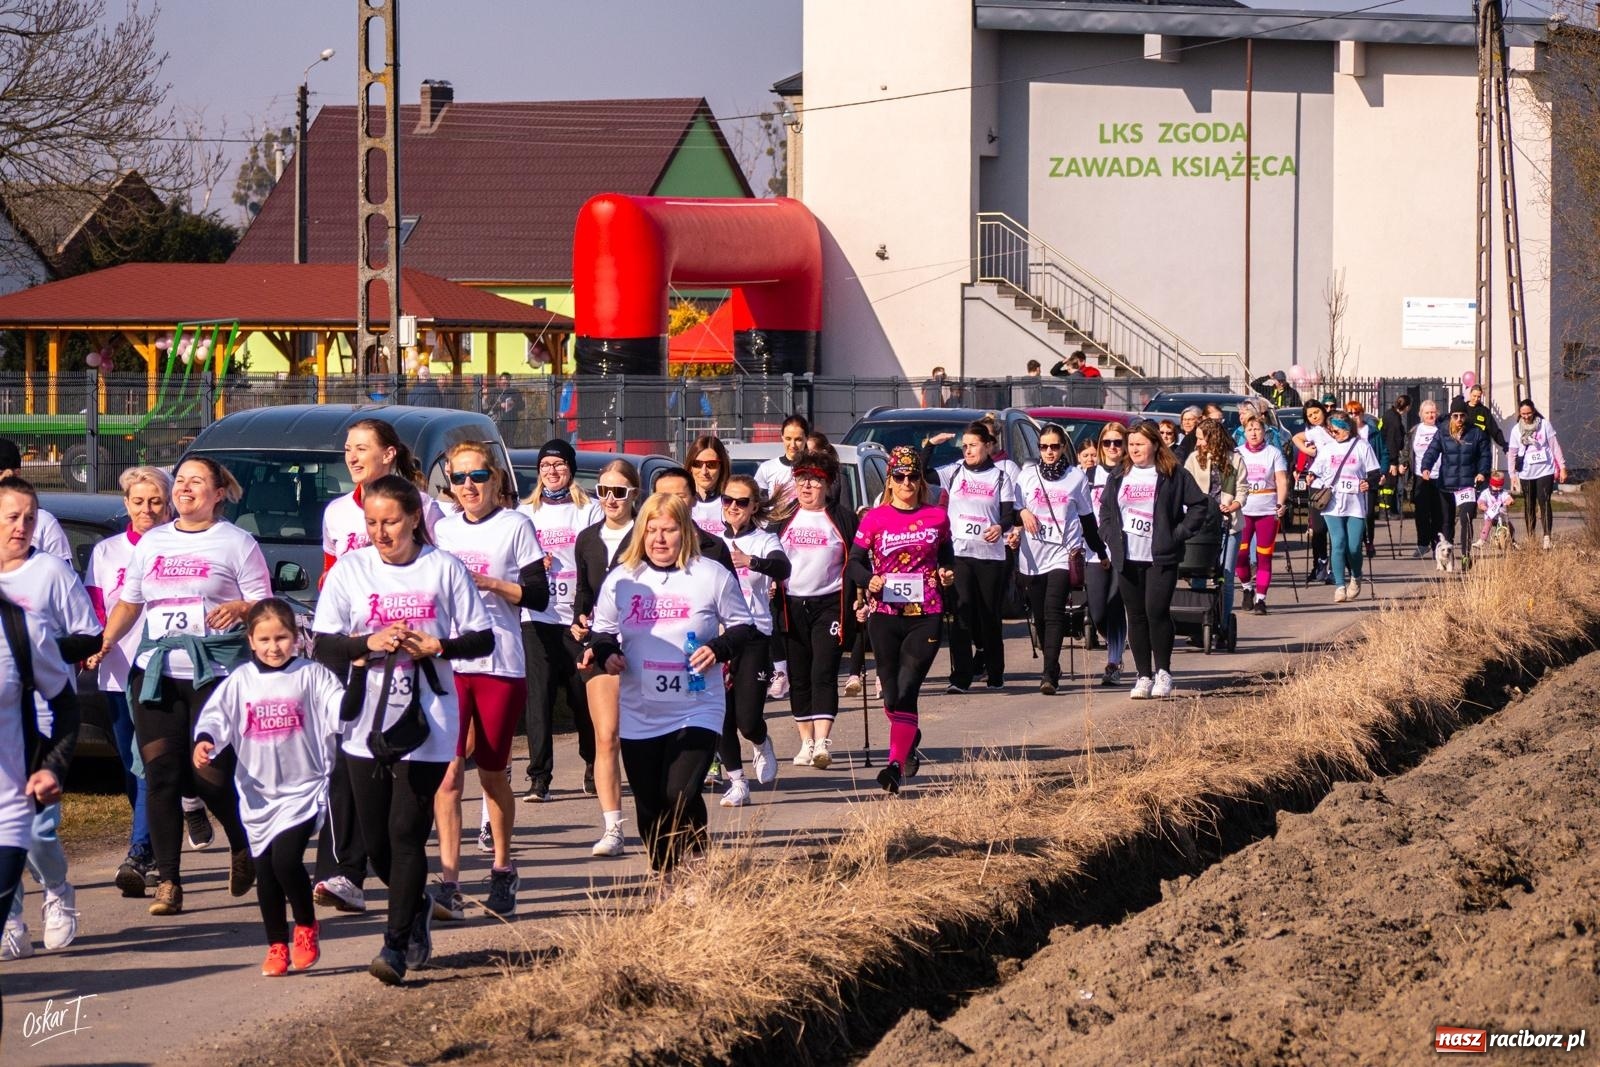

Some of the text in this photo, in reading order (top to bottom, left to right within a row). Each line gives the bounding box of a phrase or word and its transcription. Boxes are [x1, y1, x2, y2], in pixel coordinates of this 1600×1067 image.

[1100, 122, 1247, 144] LKS ZGODA
[1049, 151, 1297, 181] ZAWADA KSIĄŻĘCA
[1341, 480, 1352, 490] 16
[965, 523, 981, 535] 20
[1130, 517, 1152, 533] 103
[543, 530, 564, 539] BIEG
[544, 536, 571, 545] KOBIET
[164, 558, 192, 567] BIEG
[163, 567, 203, 576] KOBIET
[548, 582, 568, 597] 39
[893, 583, 912, 596] 55
[383, 595, 418, 608] BIEG
[643, 599, 673, 609] BIEG
[387, 606, 431, 620] KOBIET
[643, 609, 683, 619] KOBIET
[162, 611, 188, 630] 73
[656, 675, 682, 693] 34
[256, 703, 288, 718] BIEG
[260, 715, 300, 730] KOBIET
